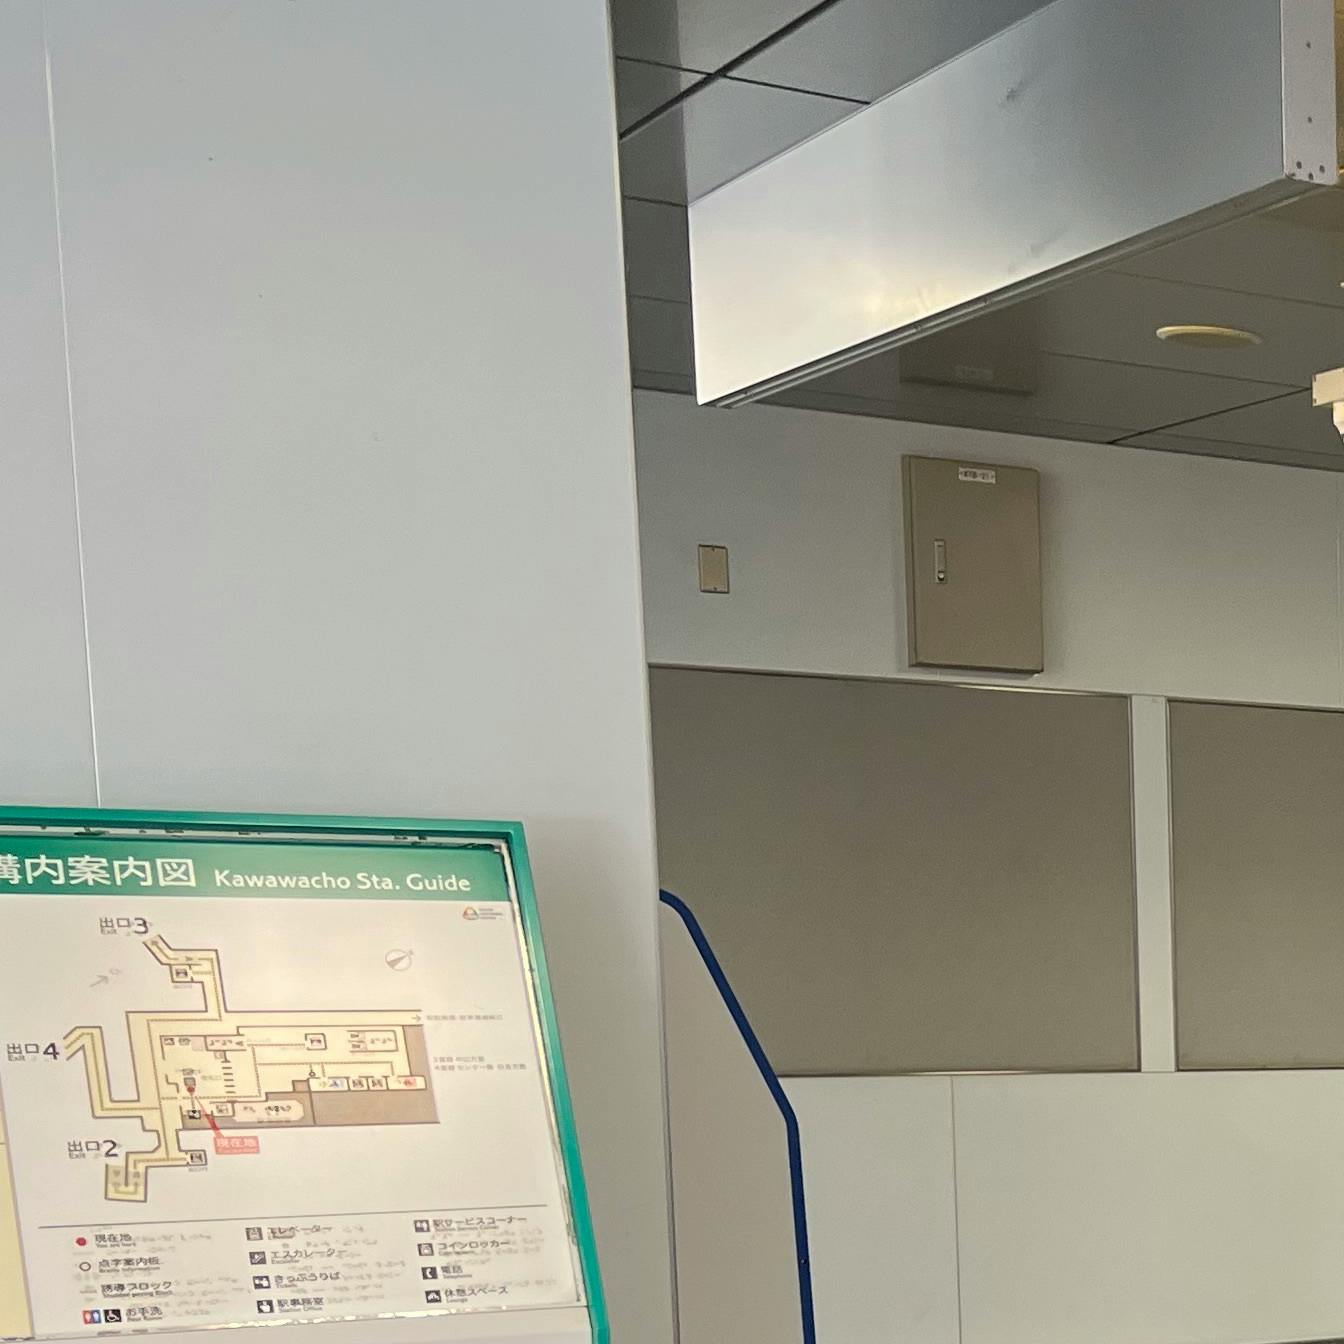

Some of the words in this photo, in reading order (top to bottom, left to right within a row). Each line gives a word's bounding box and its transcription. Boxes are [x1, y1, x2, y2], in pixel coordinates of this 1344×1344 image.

[214, 869, 351, 889] Kawawacho
[356, 872, 400, 891] Sta.
[406, 873, 471, 892] Guide
[438, 1239, 510, 1250] コインロッカー
